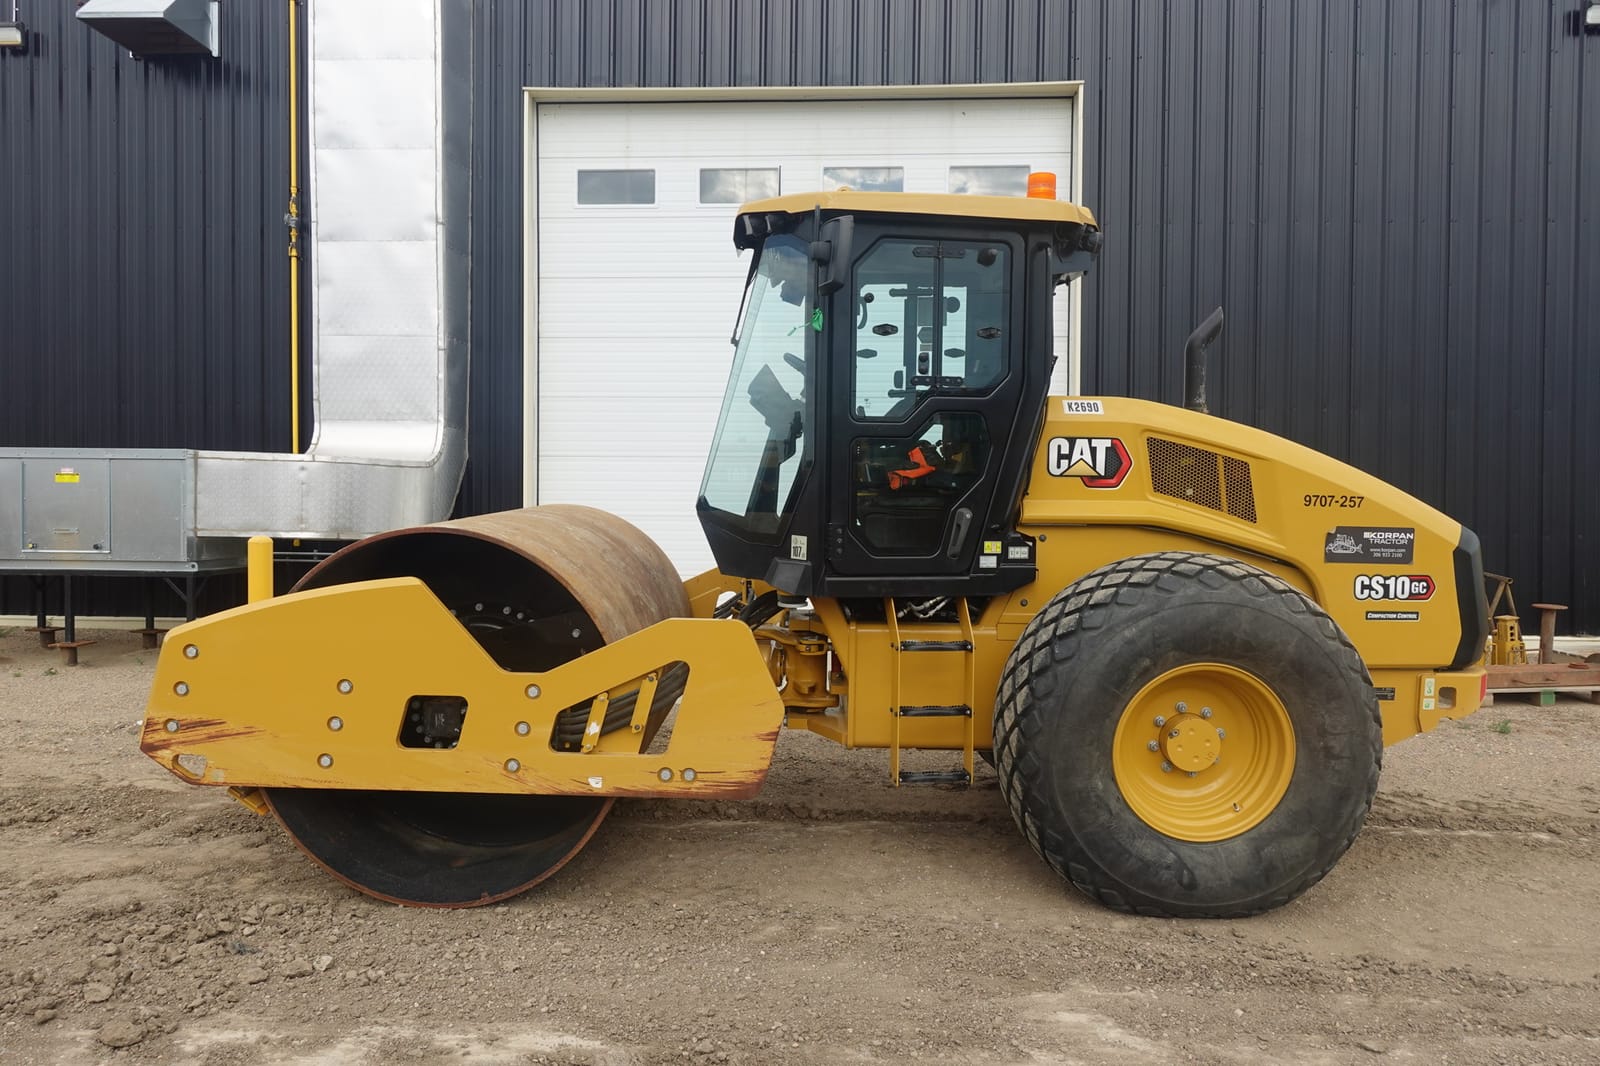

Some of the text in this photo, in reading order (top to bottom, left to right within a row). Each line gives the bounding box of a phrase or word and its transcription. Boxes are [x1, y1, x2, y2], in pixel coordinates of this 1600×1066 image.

[1067, 402, 1099, 412] K2690
[1049, 438, 1112, 476] CAT
[1303, 494, 1364, 508] 9707-257
[1364, 531, 1413, 539] KORPAN
[793, 545, 802, 558] 107
[1355, 575, 1427, 600] CS10 GC
